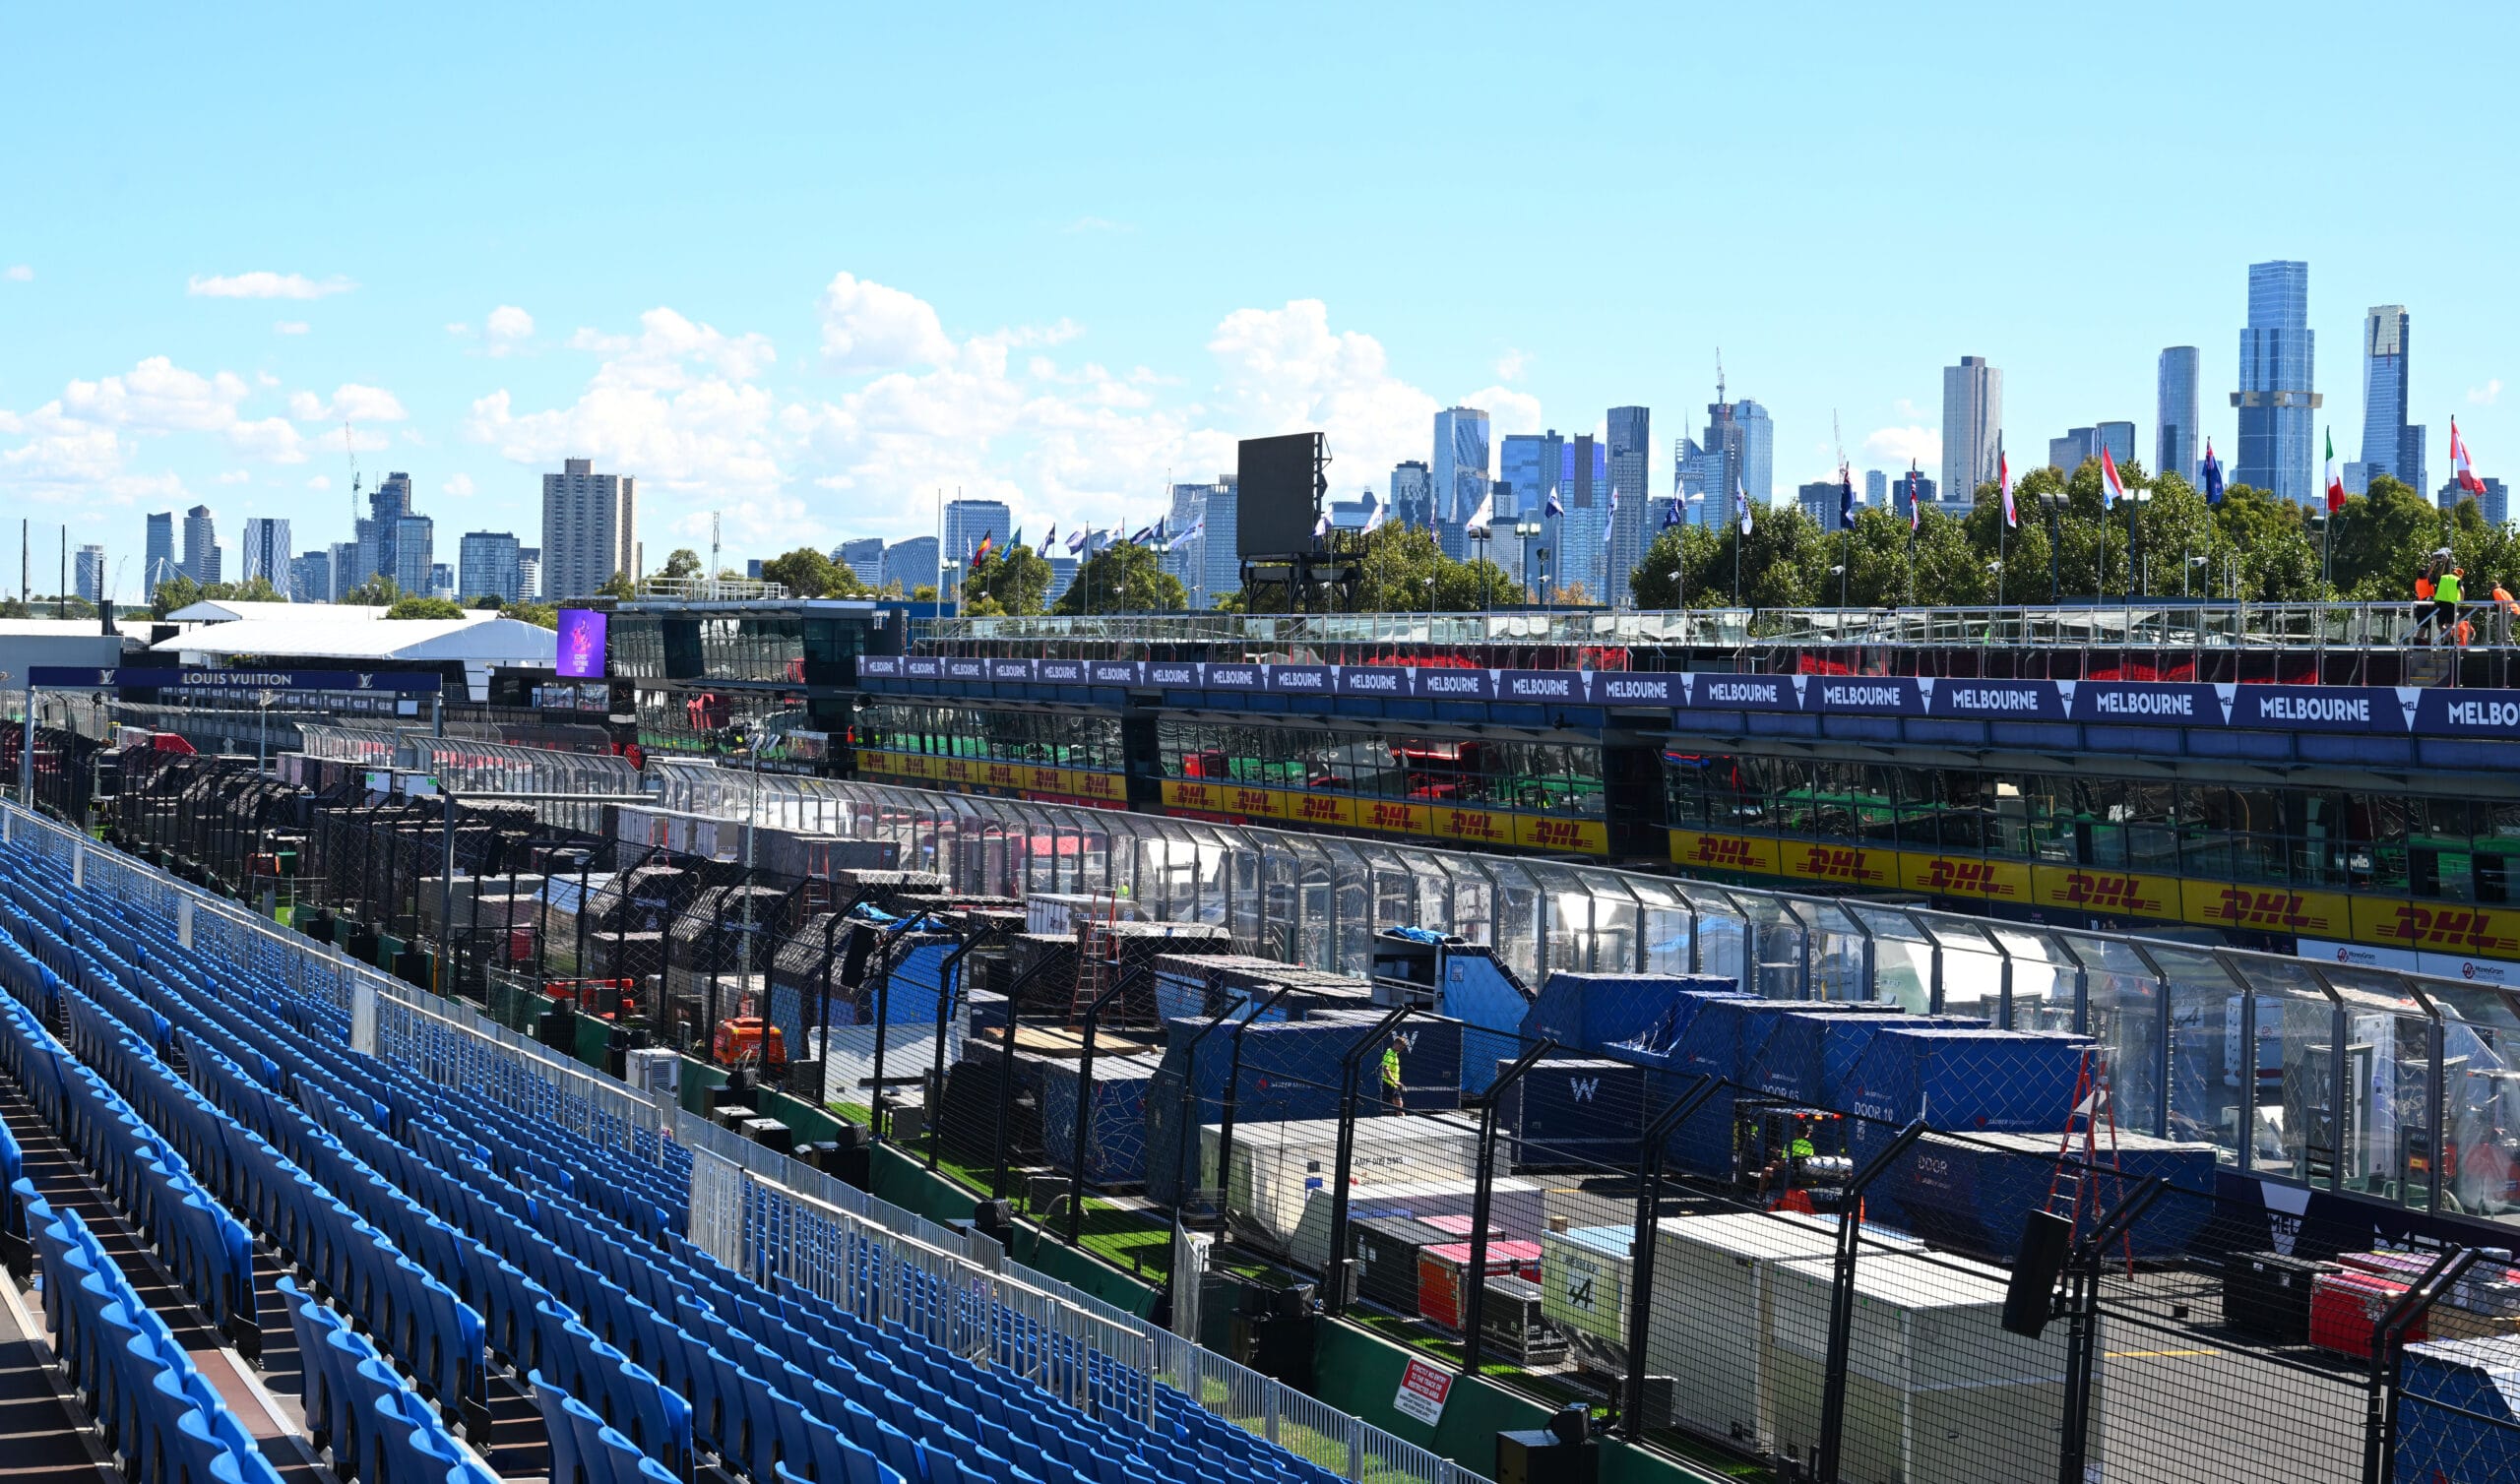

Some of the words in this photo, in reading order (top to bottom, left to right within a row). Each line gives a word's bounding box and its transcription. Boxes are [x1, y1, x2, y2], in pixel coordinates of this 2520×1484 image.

[869, 661, 894, 673] MELBOURNE
[909, 662, 935, 675] MELBOURNE
[951, 663, 979, 676] MELBOURNE
[996, 665, 1027, 678] MELBOURNE
[1044, 666, 1077, 679] MELBOURNE
[1097, 667, 1131, 681] MELBOURNE
[1152, 669, 1190, 684] MELBOURNE
[183, 672, 226, 685] LOUIS
[230, 673, 292, 686] VUITTON
[1213, 670, 1253, 685] MELBOURNE
[1278, 672, 1322, 687] MELBOURNE
[1350, 674, 1397, 690] MELBOURNE
[1426, 676, 1480, 693] MELBOURNE
[1512, 678, 1569, 696] MELBOURNE
[1606, 681, 1668, 699] MELBOURNE
[1708, 683, 1778, 703] MELBOURNE
[1823, 686, 1901, 706] MELBOURNE
[1952, 689, 2039, 711] MELBOURNE
[2096, 692, 2193, 715] MELBOURNE
[2260, 697, 2369, 721] MELBOURNE
[2448, 702, 2520, 726] MELBO
[366, 773, 375, 782] 16
[426, 776, 438, 786] 16
[1176, 784, 1210, 806] DHL
[1236, 790, 1272, 813] DHL
[1300, 796, 1339, 820] DHL
[1373, 804, 1415, 828] DHL
[1450, 811, 1496, 837] DHL
[1535, 821, 1584, 847] DHL
[1697, 836, 1756, 866] DHL
[1807, 848, 1871, 879] DHL
[1928, 860, 2001, 894] DHL
[2066, 874, 2145, 909] DHL
[2218, 889, 2310, 928] DHL
[2393, 906, 2499, 949] DHL
[2348, 951, 2376, 961] MoneyGram
[2475, 965, 2505, 975] MoneyGram
[1570, 1078, 1599, 1103] W
[1854, 1101, 1881, 1120] DOOR
[1883, 1107, 1894, 1122] 10
[1918, 1155, 1948, 1176] DOOR
